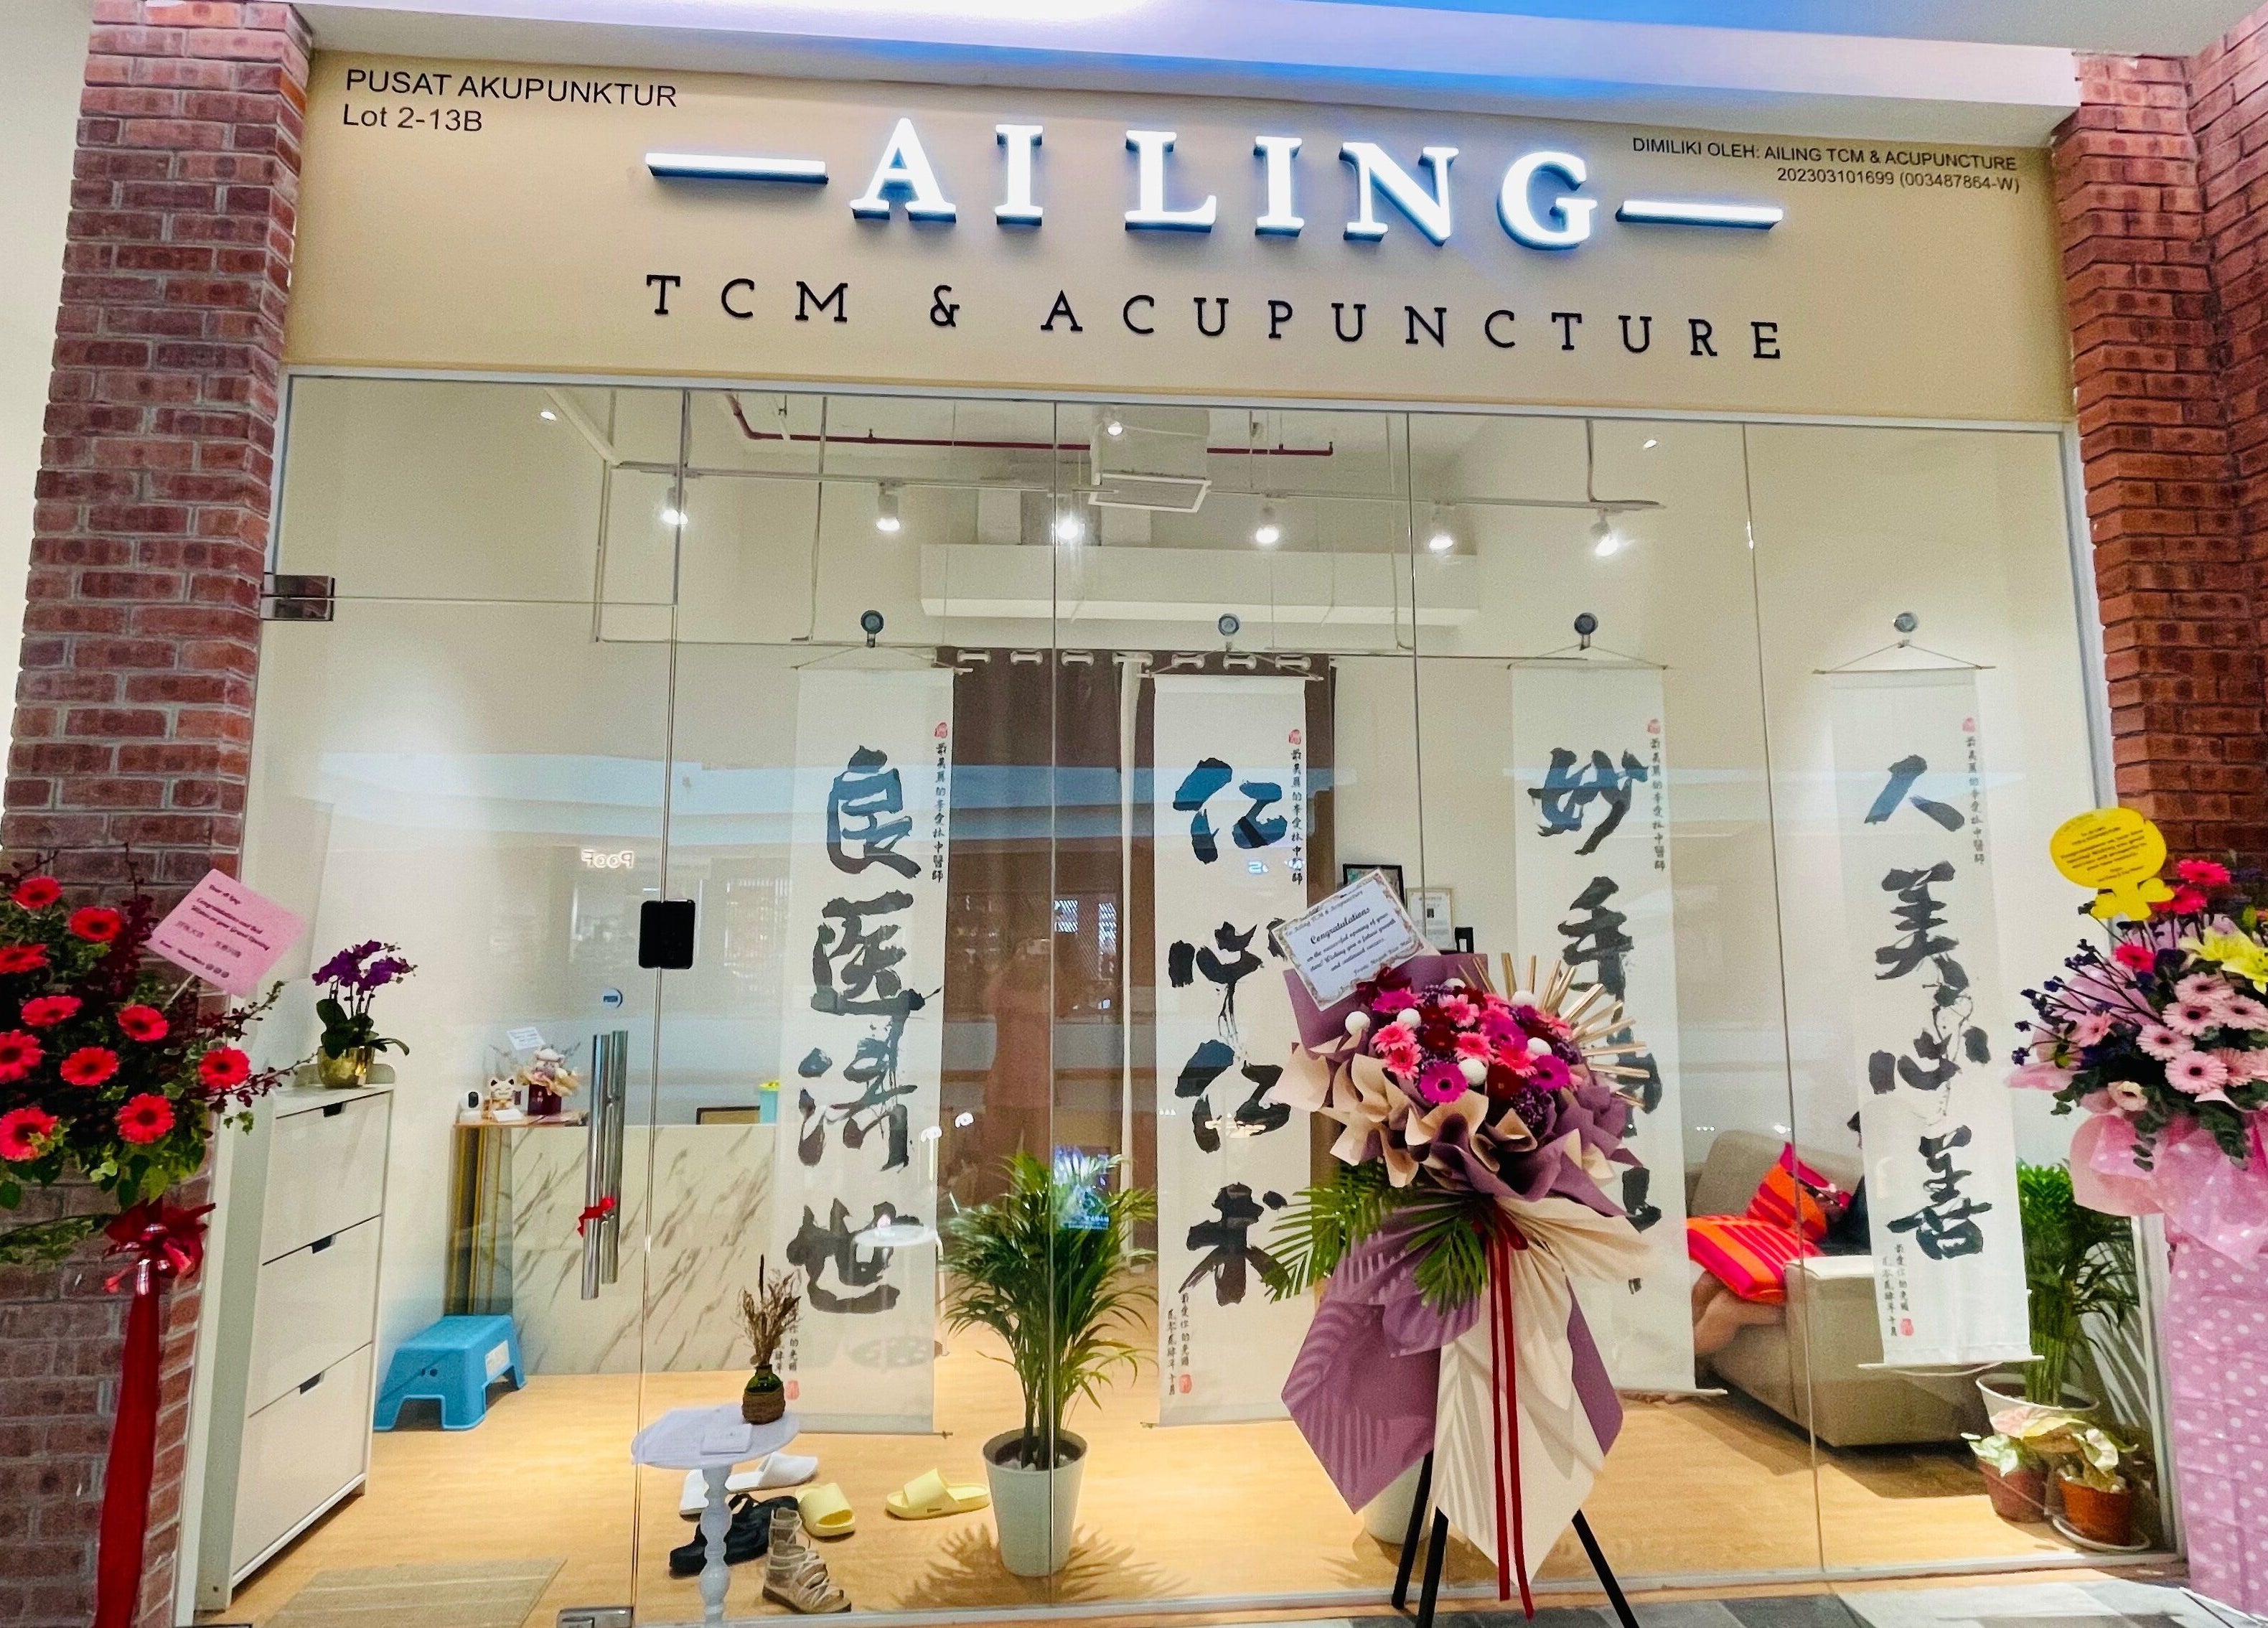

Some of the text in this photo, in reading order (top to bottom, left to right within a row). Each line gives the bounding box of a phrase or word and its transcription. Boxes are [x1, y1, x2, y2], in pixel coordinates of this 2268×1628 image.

[346, 70, 678, 108] PUSAT AKUPUNKTUR
[342, 103, 482, 133] Lot 2-13B
[1633, 138, 2017, 171] DIMILIKI OLEH: AILING TCM & ACUPUNCTURE
[1777, 168, 2020, 194] 202303101699 (003487864-W)
[646, 274, 1781, 360] TCM & ACUPUNCTURE
[1311, 907, 1369, 944] Congratulations
